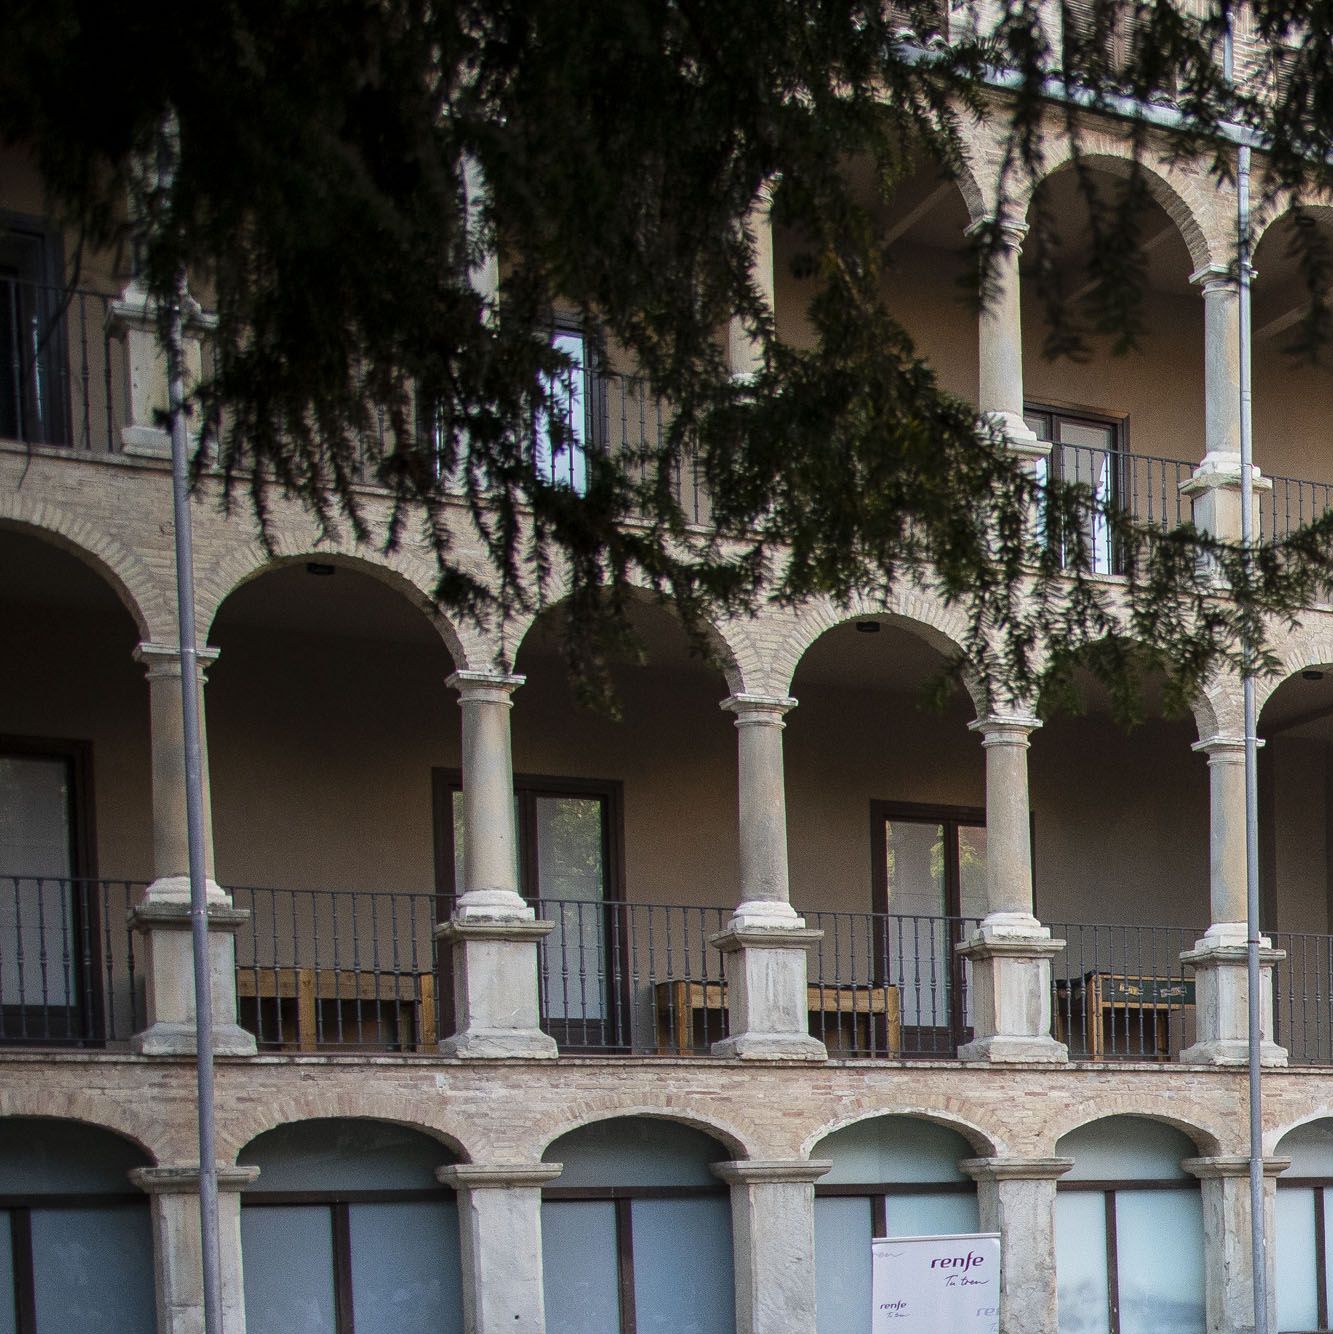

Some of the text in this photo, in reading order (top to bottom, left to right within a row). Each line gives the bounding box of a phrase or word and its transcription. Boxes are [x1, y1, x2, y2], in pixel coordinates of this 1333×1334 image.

[930, 1250, 984, 1273] renfe
[944, 1275, 991, 1287] Tu tren
[880, 1299, 907, 1311] renfe
